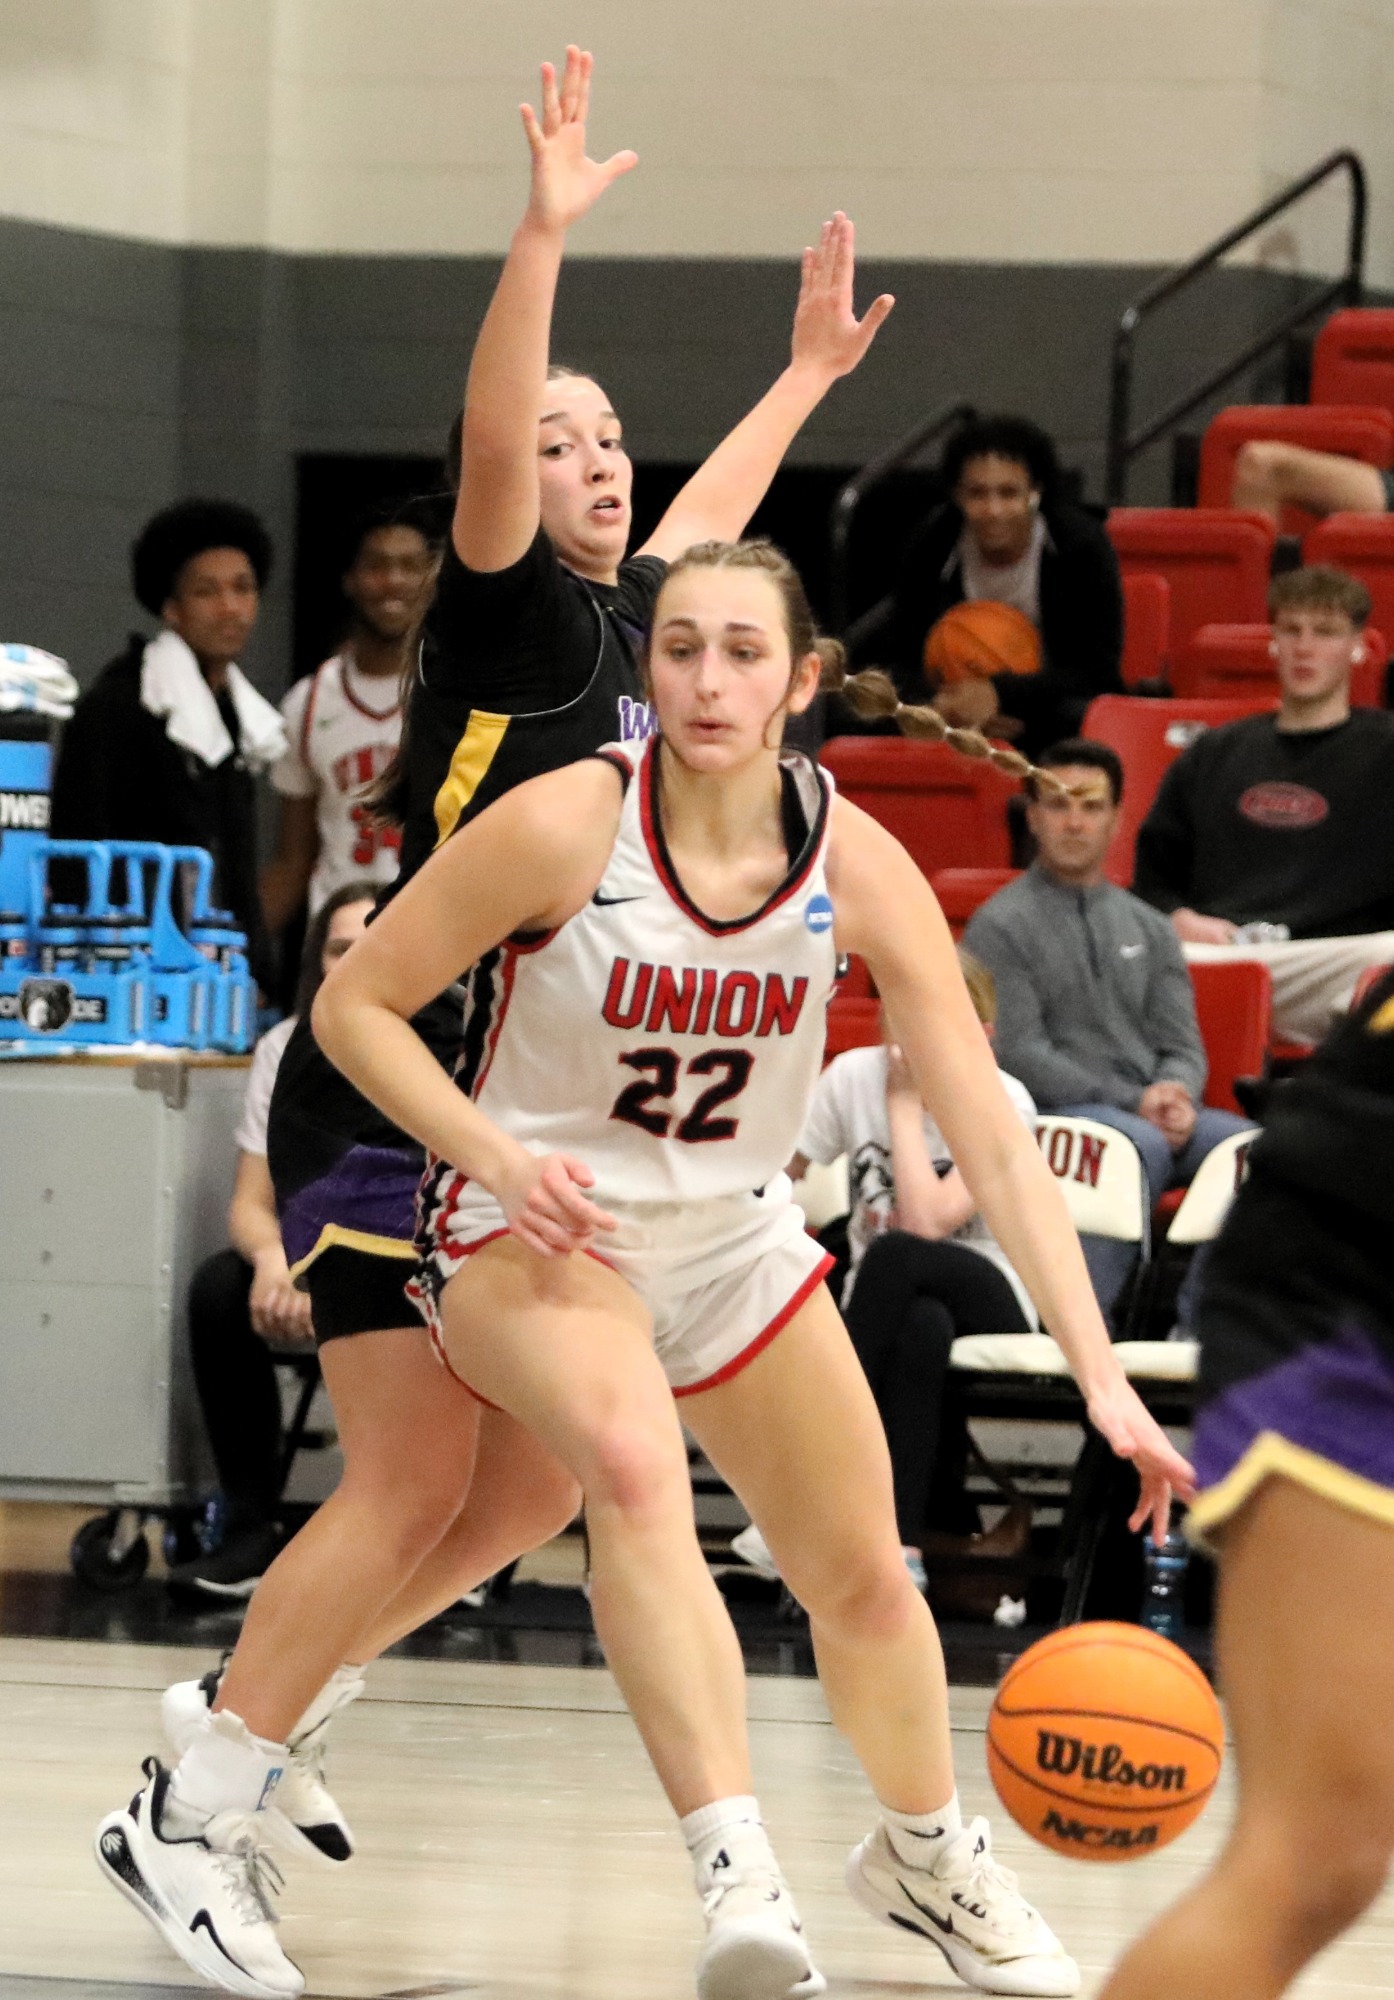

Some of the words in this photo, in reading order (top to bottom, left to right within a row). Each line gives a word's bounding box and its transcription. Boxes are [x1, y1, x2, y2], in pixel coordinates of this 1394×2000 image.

[602, 956, 808, 1037] UNION
[609, 1046, 754, 1142] 22
[1037, 1729, 1186, 1791] Wilson
